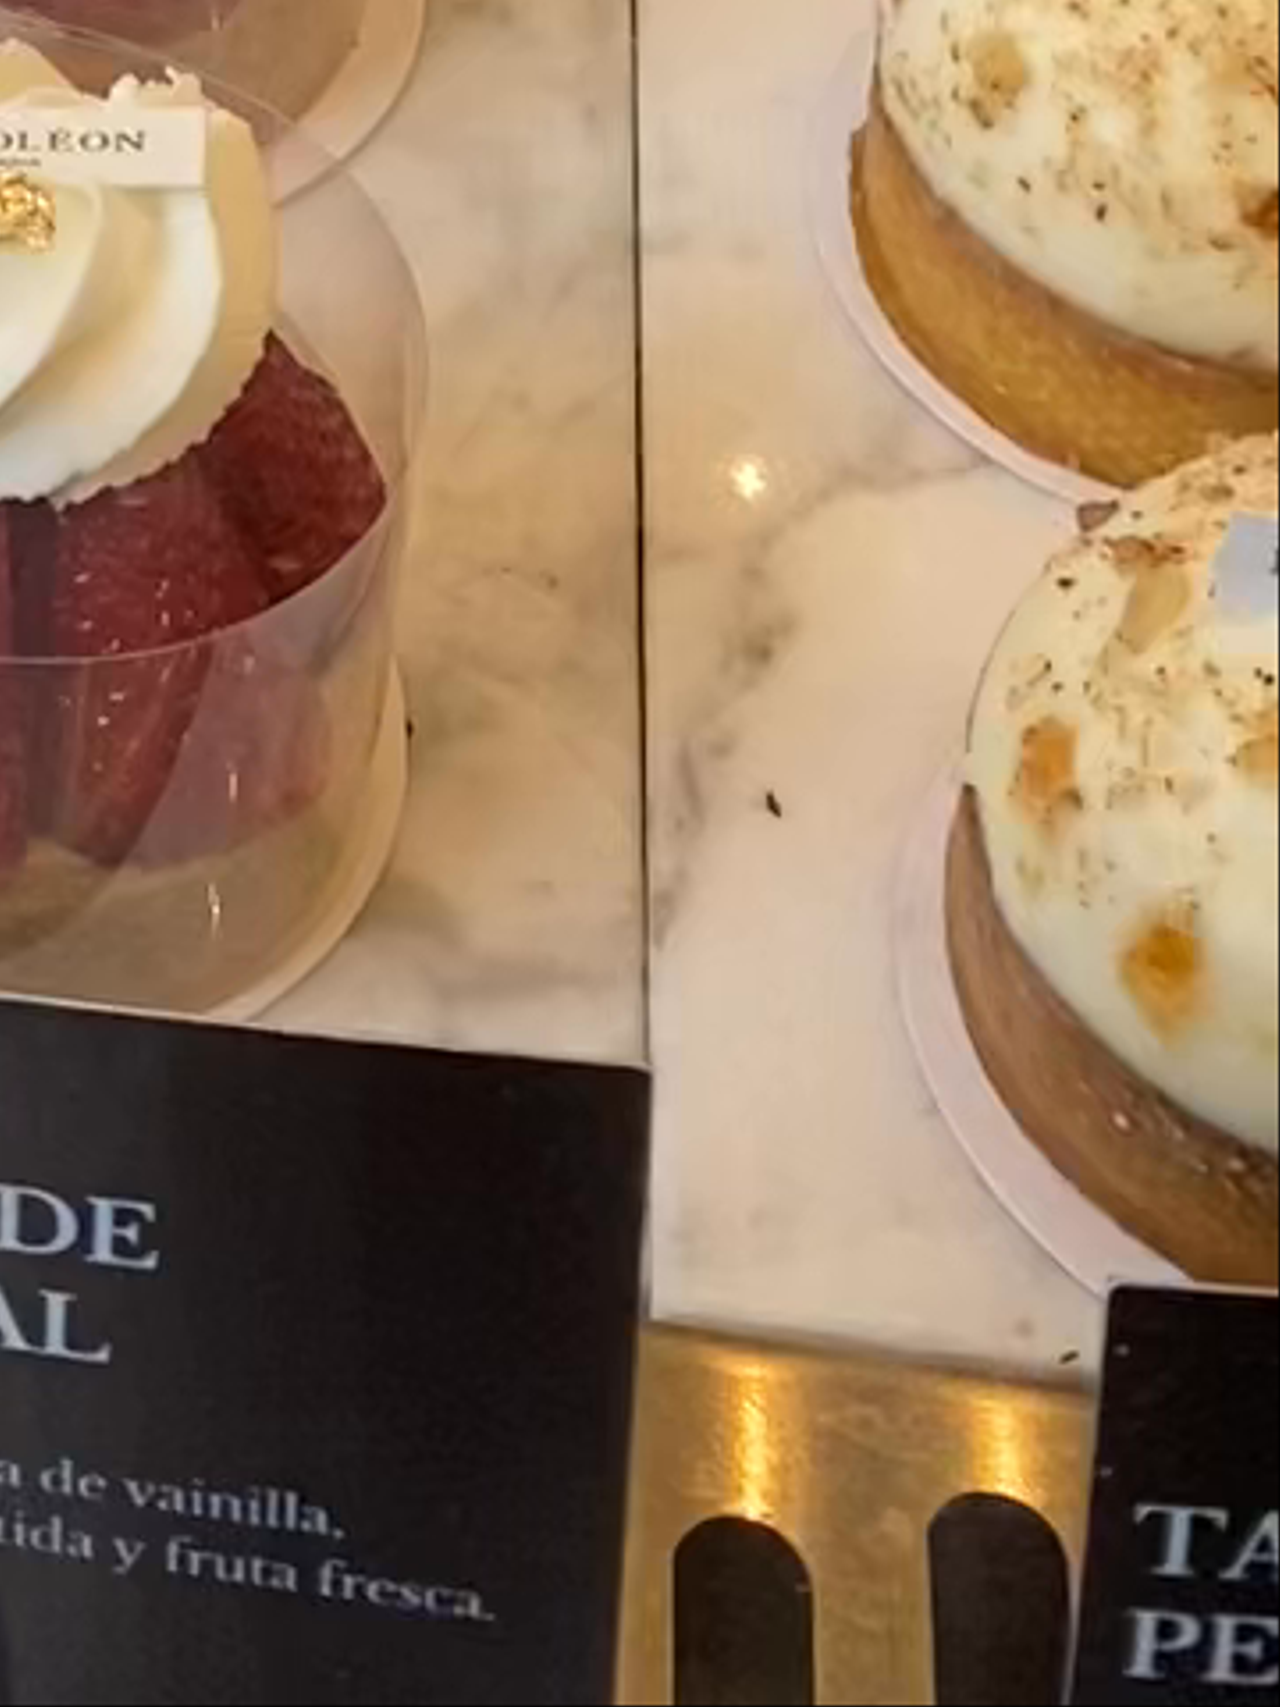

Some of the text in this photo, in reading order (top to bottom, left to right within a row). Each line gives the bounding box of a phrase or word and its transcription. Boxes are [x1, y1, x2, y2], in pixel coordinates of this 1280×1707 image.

[40, 1456, 107, 1500] de
[112, 1536, 145, 1574] y
[166, 1535, 299, 1593] fruta
[319, 1558, 496, 1621] fresca.
